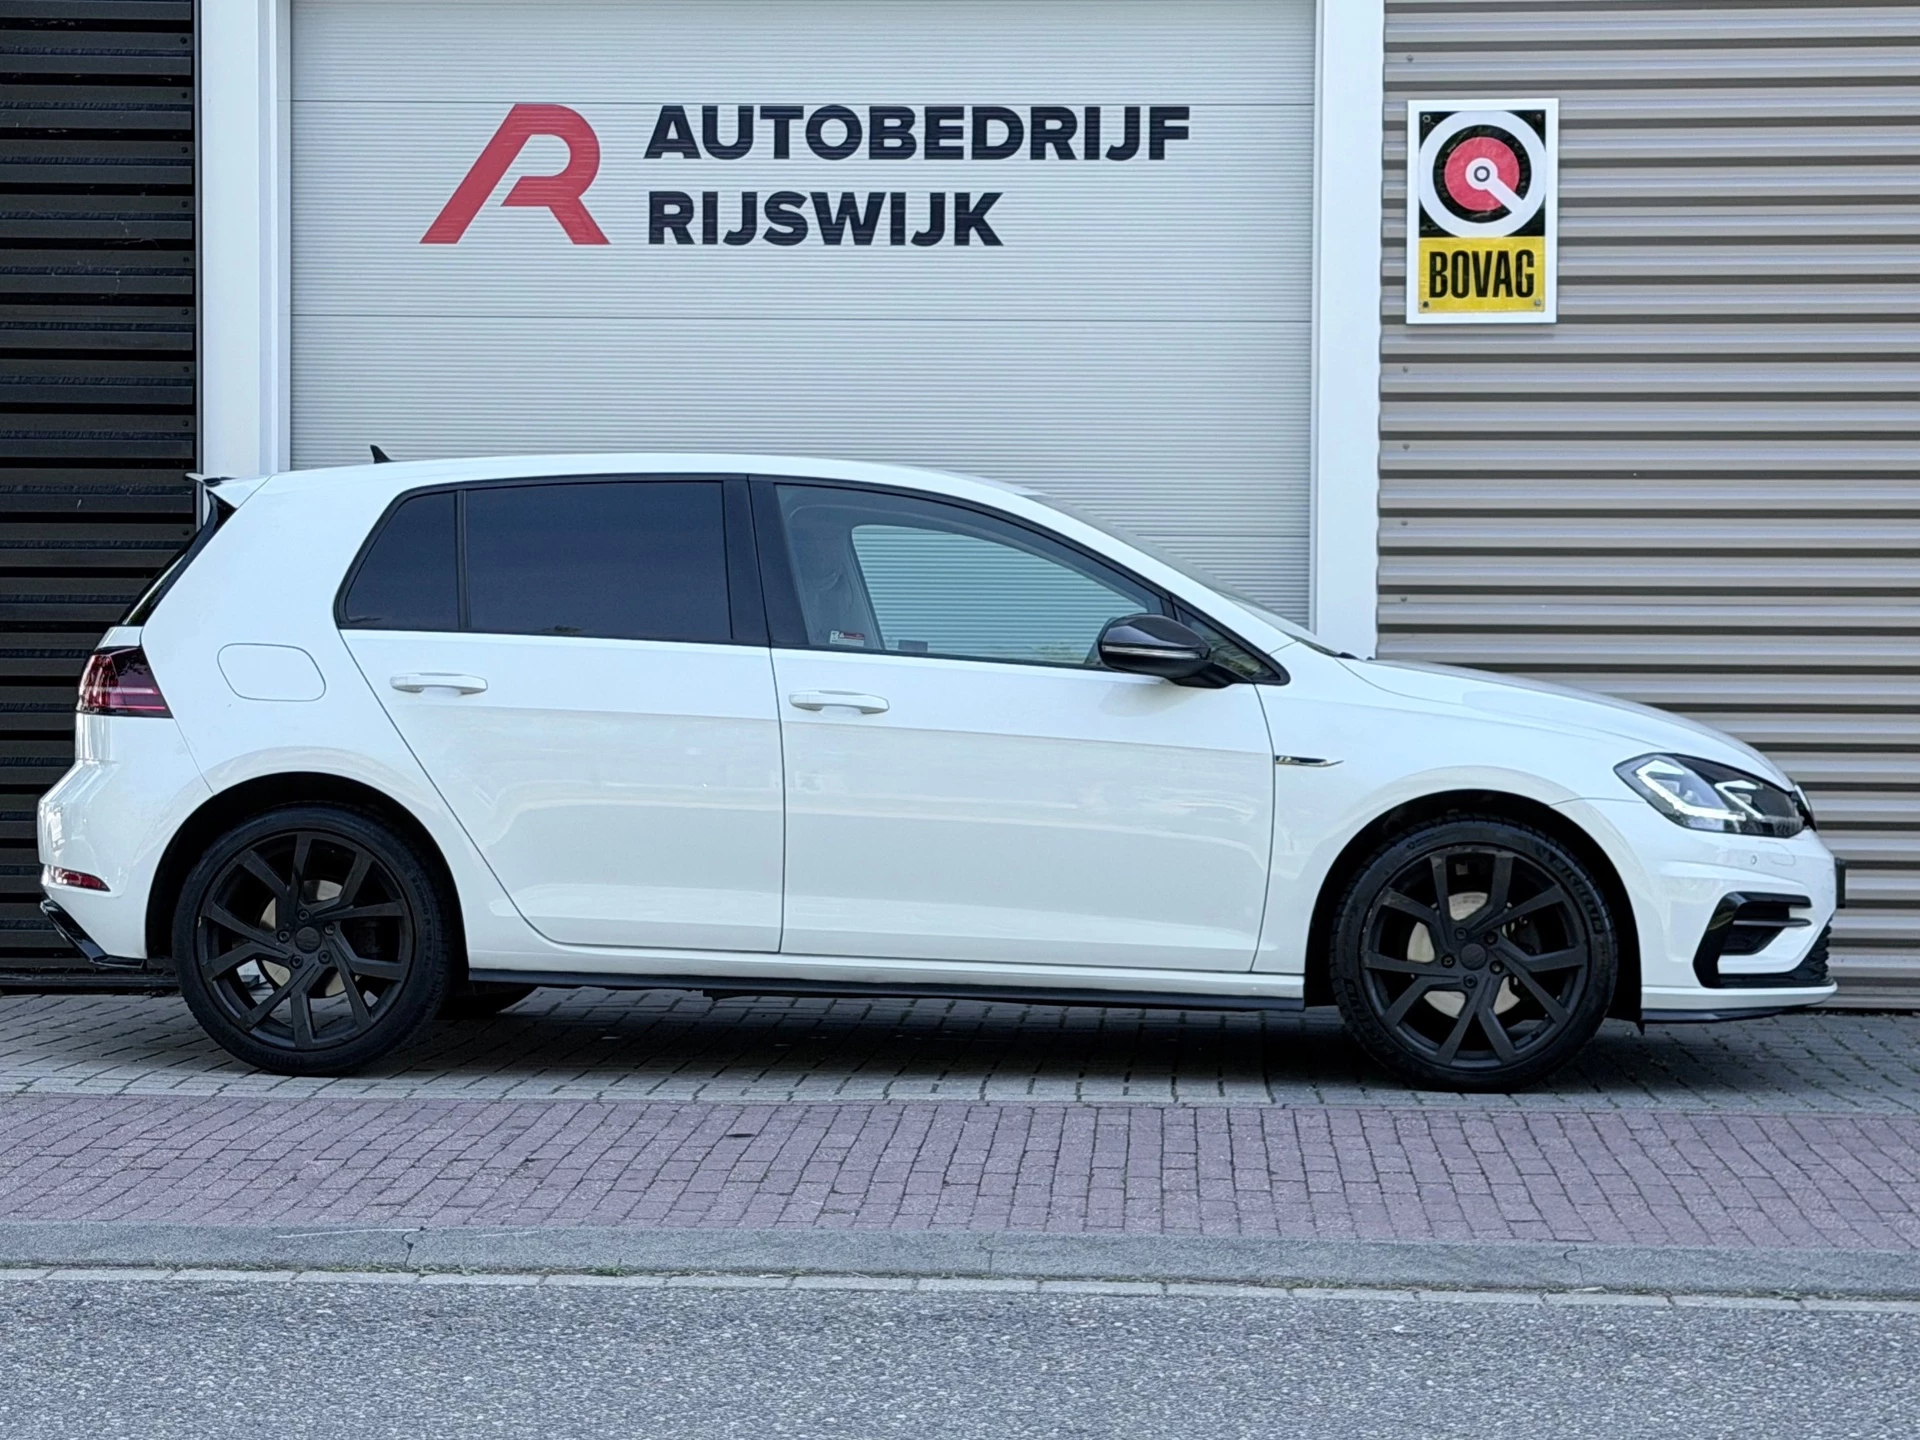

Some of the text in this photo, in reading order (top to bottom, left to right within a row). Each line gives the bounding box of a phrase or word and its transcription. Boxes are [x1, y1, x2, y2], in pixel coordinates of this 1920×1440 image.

[644, 105, 1190, 160] AUTOBEDRIJF
[648, 191, 1003, 246] RIJSWIJK
[1429, 249, 1535, 299] BOVAG
